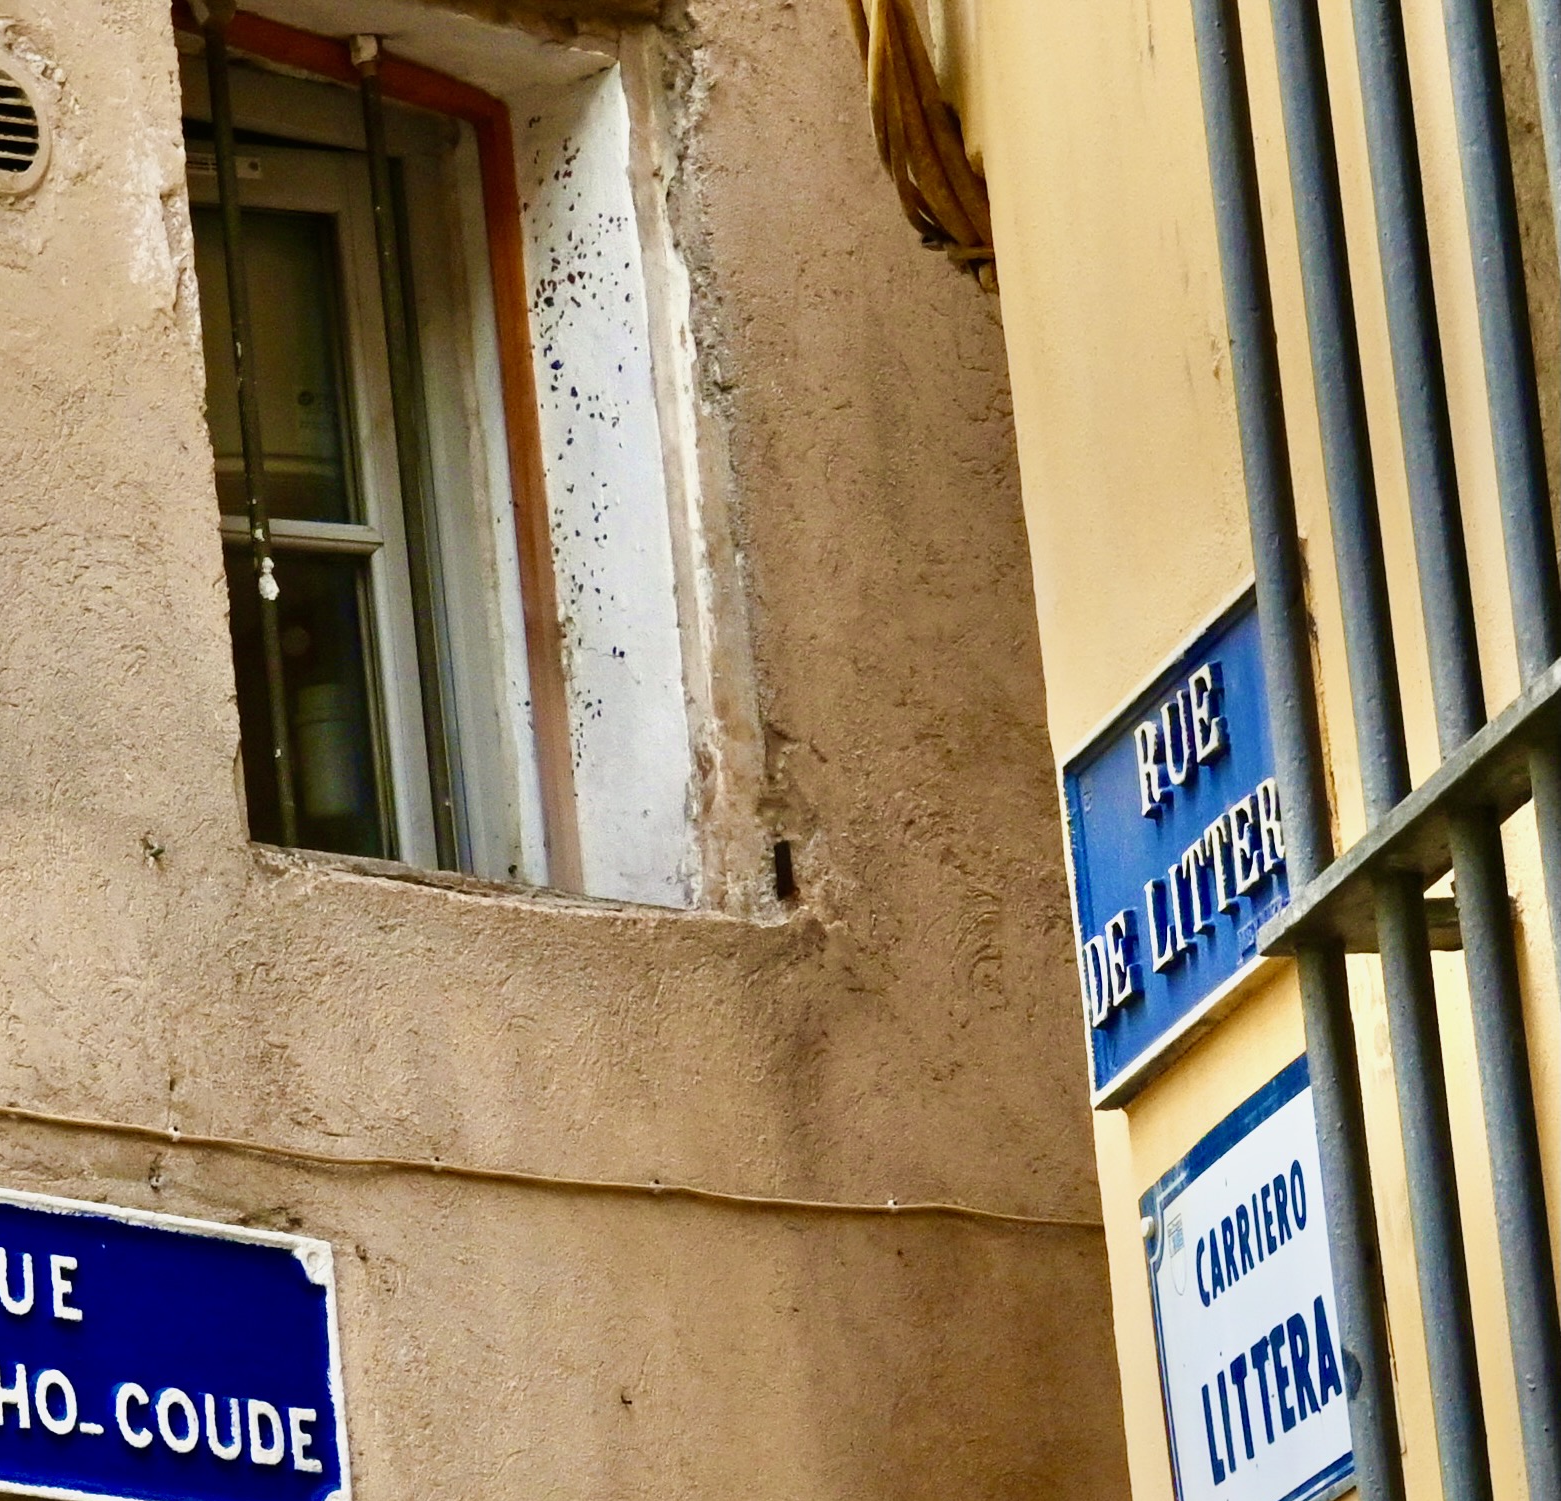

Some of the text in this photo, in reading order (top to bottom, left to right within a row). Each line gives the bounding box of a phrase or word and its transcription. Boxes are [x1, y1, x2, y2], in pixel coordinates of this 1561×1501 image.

[1133, 661, 1230, 818] RUE
[1082, 777, 1285, 1027] DE LITTER
[1195, 1158, 1308, 1309] CARRIERO
[1201, 1293, 1343, 1487] LITTERA
